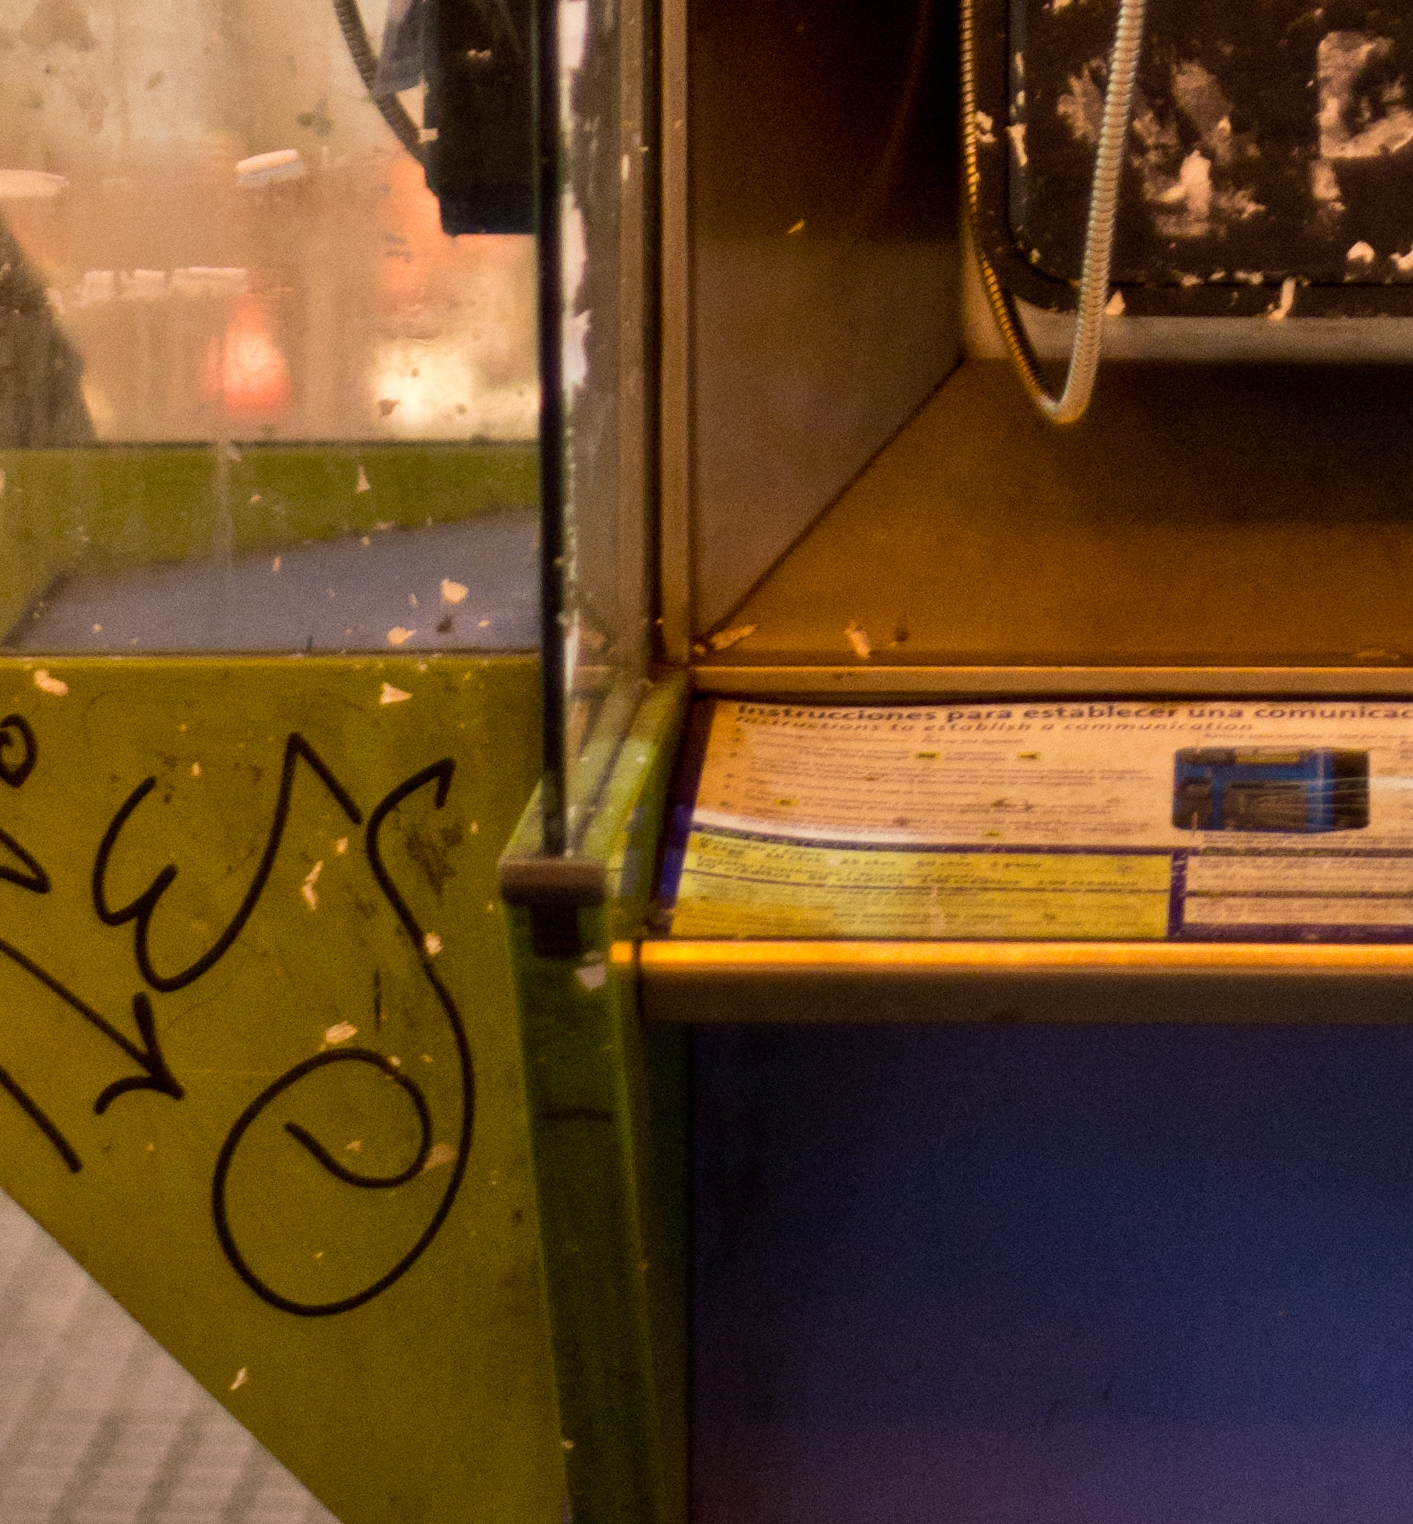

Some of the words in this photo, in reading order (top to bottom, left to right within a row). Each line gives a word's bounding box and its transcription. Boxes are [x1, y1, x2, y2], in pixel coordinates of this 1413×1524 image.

[737, 703, 936, 723] Instrucciones
[948, 706, 1012, 724] para
[1024, 703, 1180, 721] establecer
[1188, 707, 1244, 719] una
[924, 718, 1026, 733] establish
